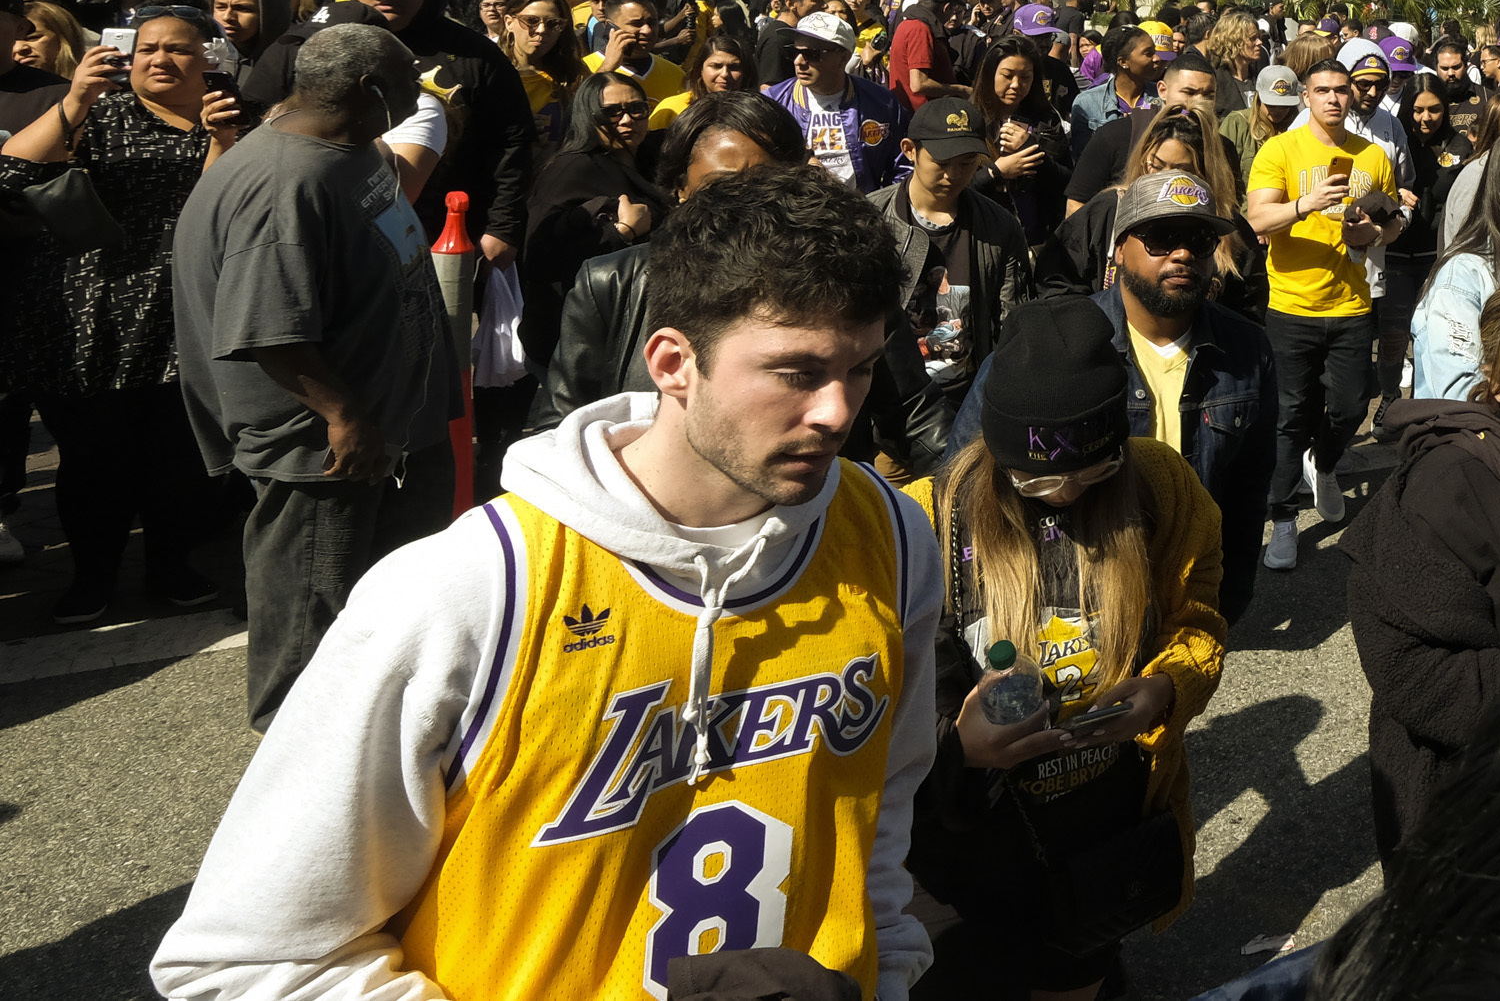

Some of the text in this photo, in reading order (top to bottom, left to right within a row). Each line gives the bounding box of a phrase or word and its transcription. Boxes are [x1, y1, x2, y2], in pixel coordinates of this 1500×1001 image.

[311, 6, 331, 24] LA
[812, 112, 842, 127] ANG
[1158, 178, 1210, 205] LAKERS
[1299, 164, 1373, 199] LARS
[1039, 513, 1065, 529] COM
[563, 633, 616, 654] adidas
[1037, 636, 1092, 669] LAKE
[530, 651, 890, 848] LAKERS
[1037, 758, 1063, 780] REST
[1066, 752, 1079, 769] IN
[1017, 774, 1065, 796] KOBE
[642, 799, 794, 1001] 8
